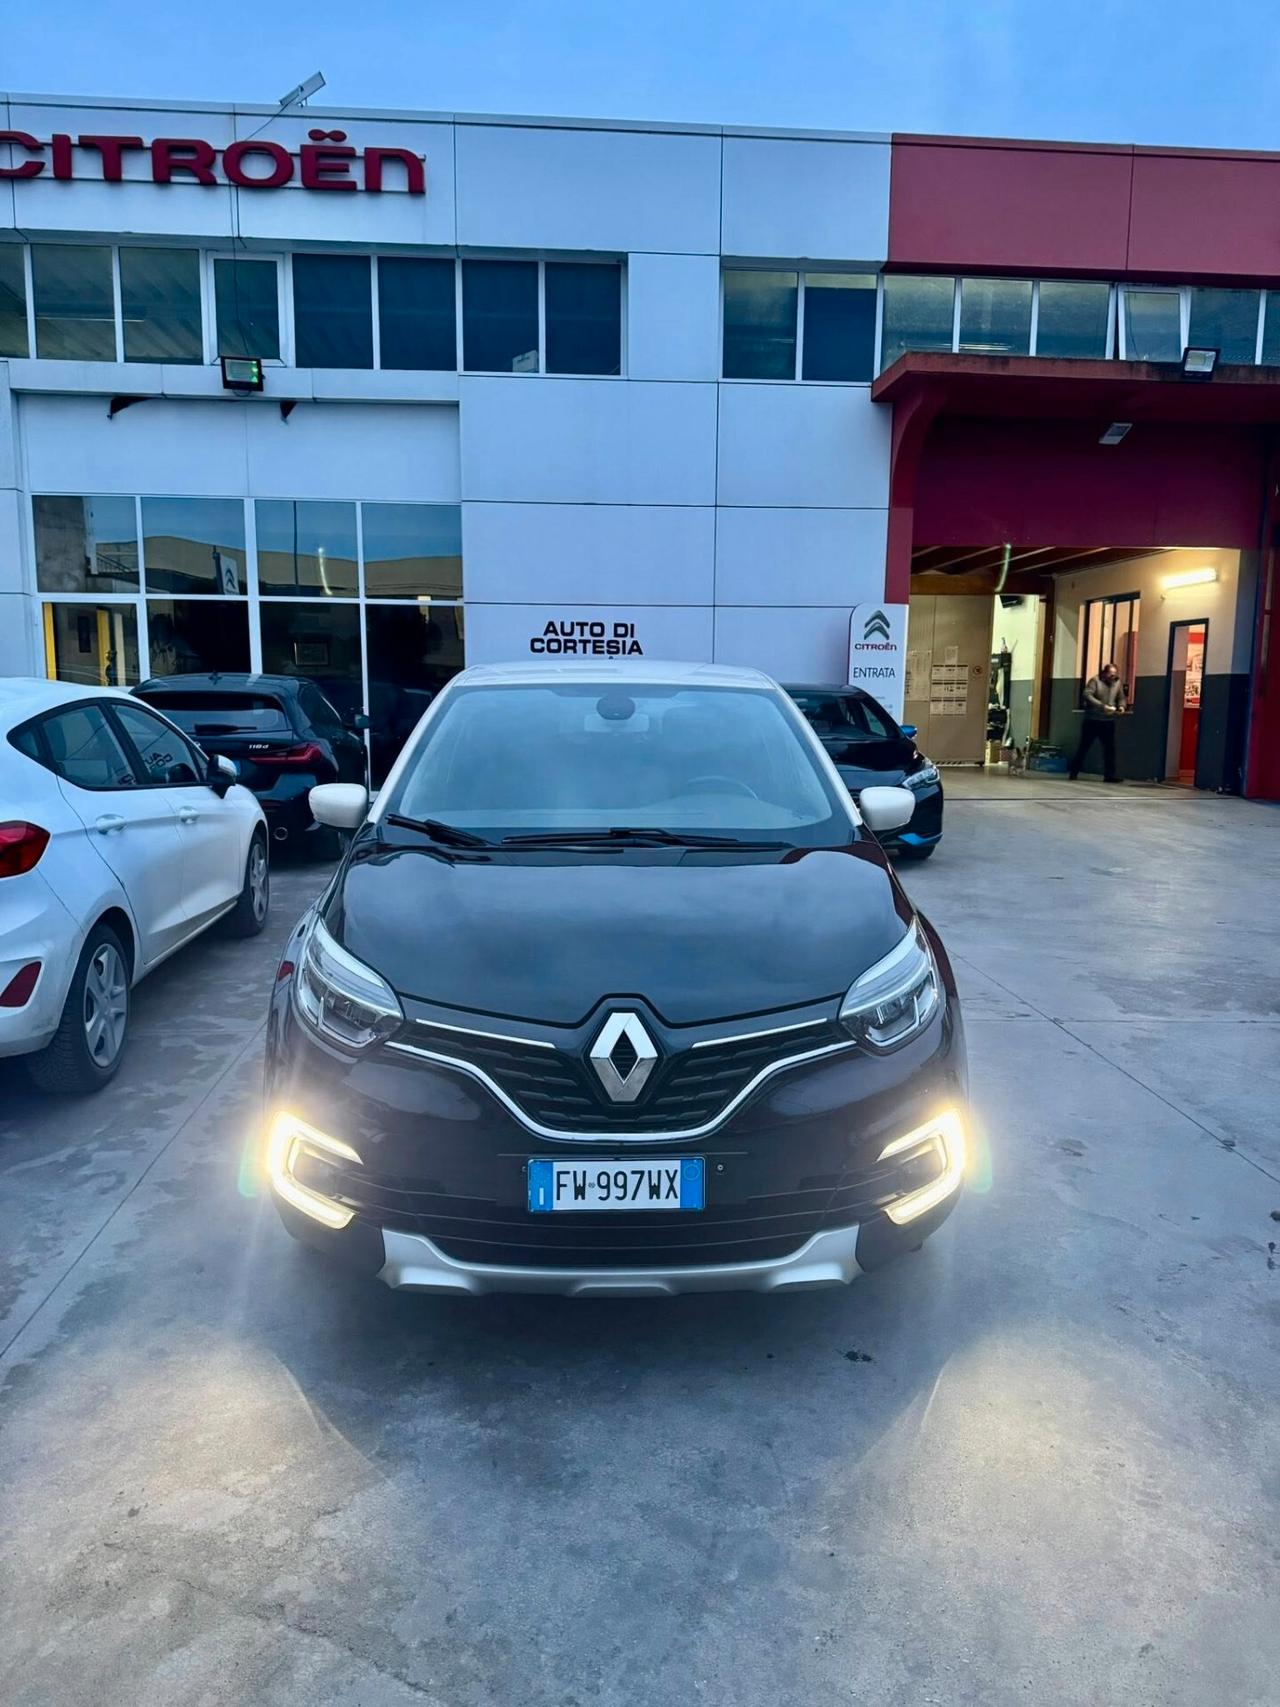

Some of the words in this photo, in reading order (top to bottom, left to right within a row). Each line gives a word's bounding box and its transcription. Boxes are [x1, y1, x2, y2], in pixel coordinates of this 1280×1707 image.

[543, 620, 606, 638] AUTO
[613, 622, 635, 639] DI
[530, 637, 644, 656] CORTESIA
[853, 667, 896, 679] ENTRATA
